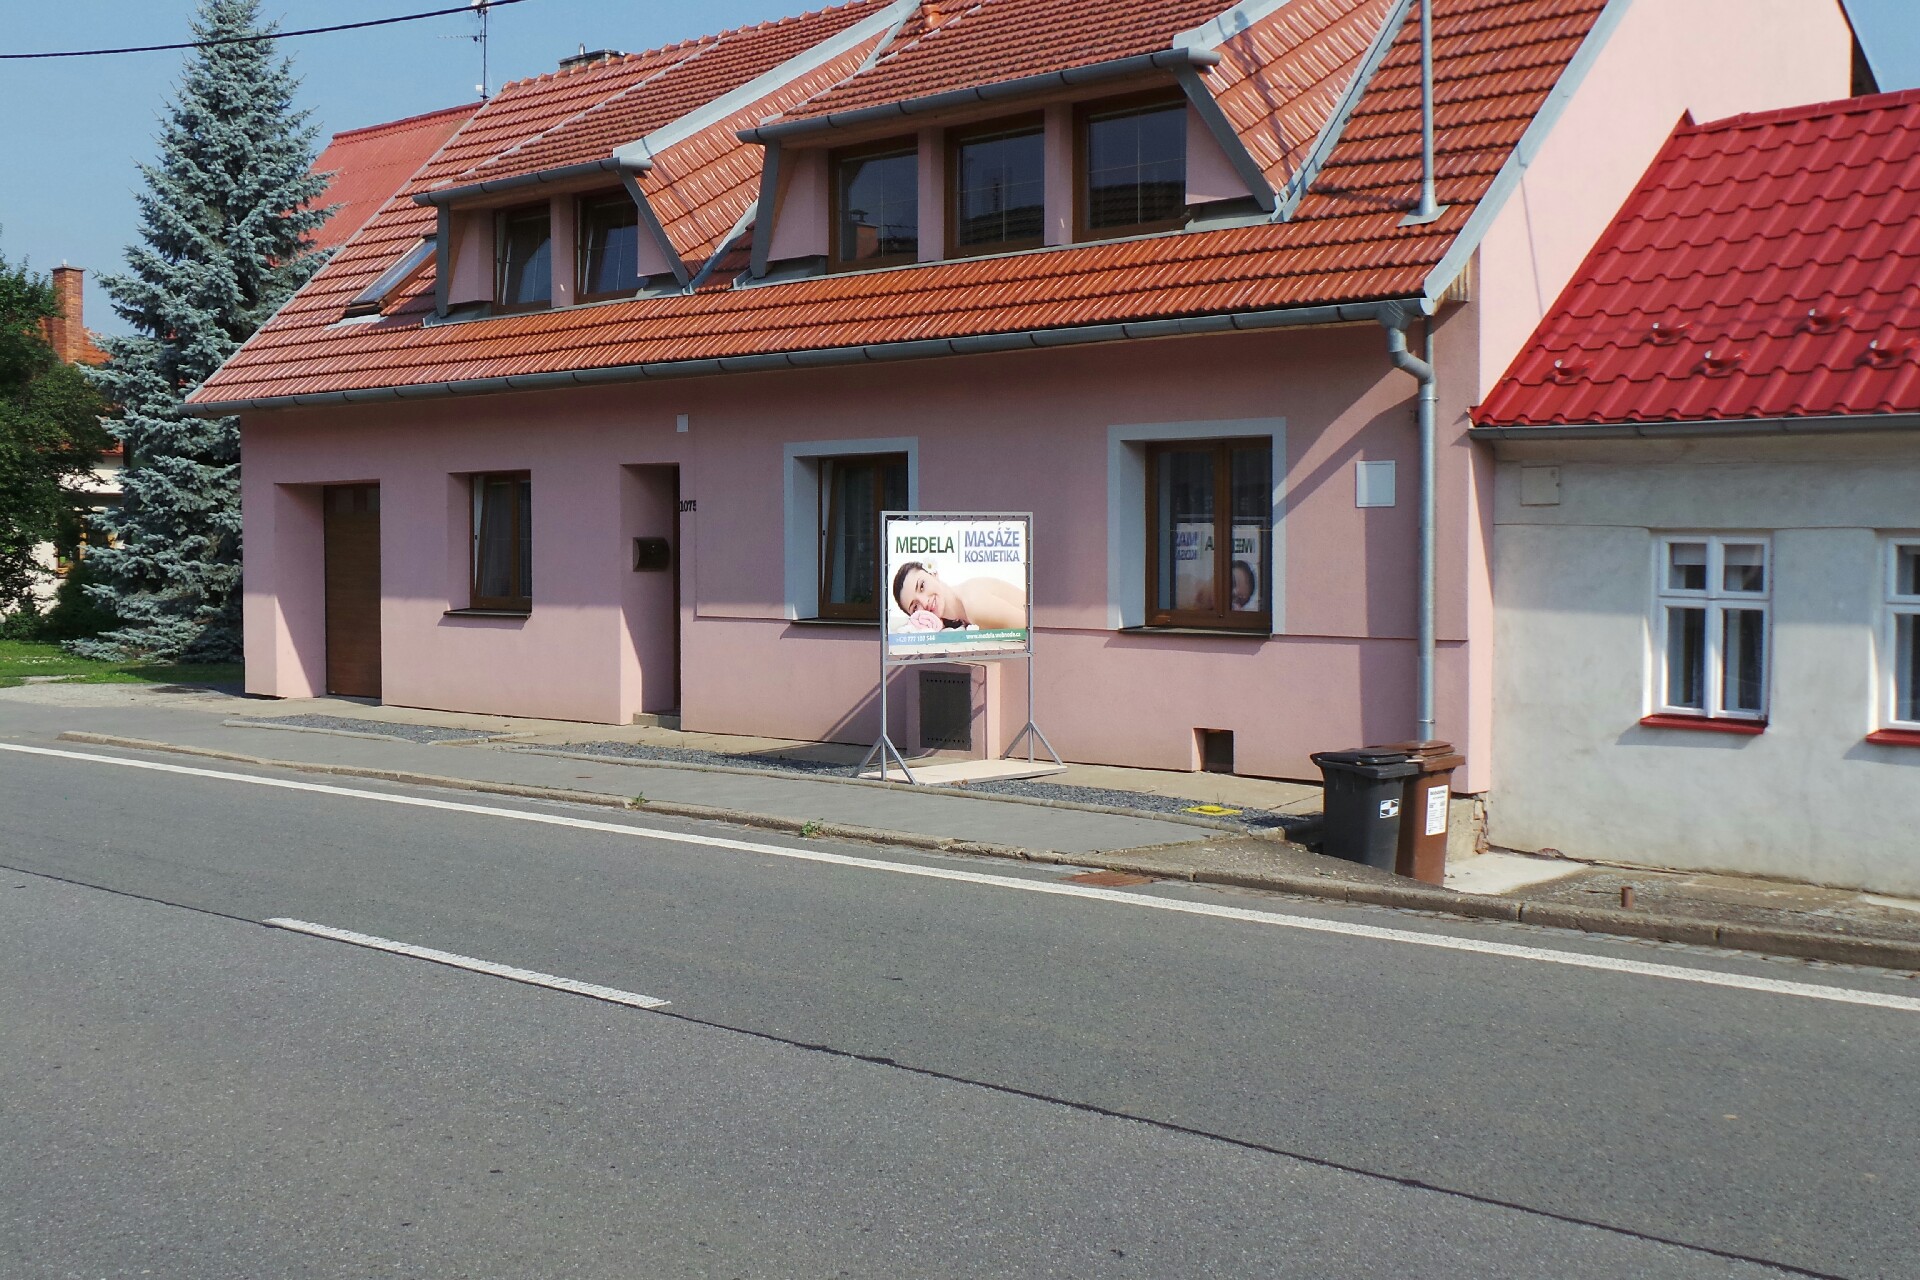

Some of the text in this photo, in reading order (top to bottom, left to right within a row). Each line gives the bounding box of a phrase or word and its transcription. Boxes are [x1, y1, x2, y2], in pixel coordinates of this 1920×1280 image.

[895, 536, 955, 554] MEDELA
[964, 527, 1020, 547] MASÁŽE
[964, 550, 1020, 563] KOSMETIKA
